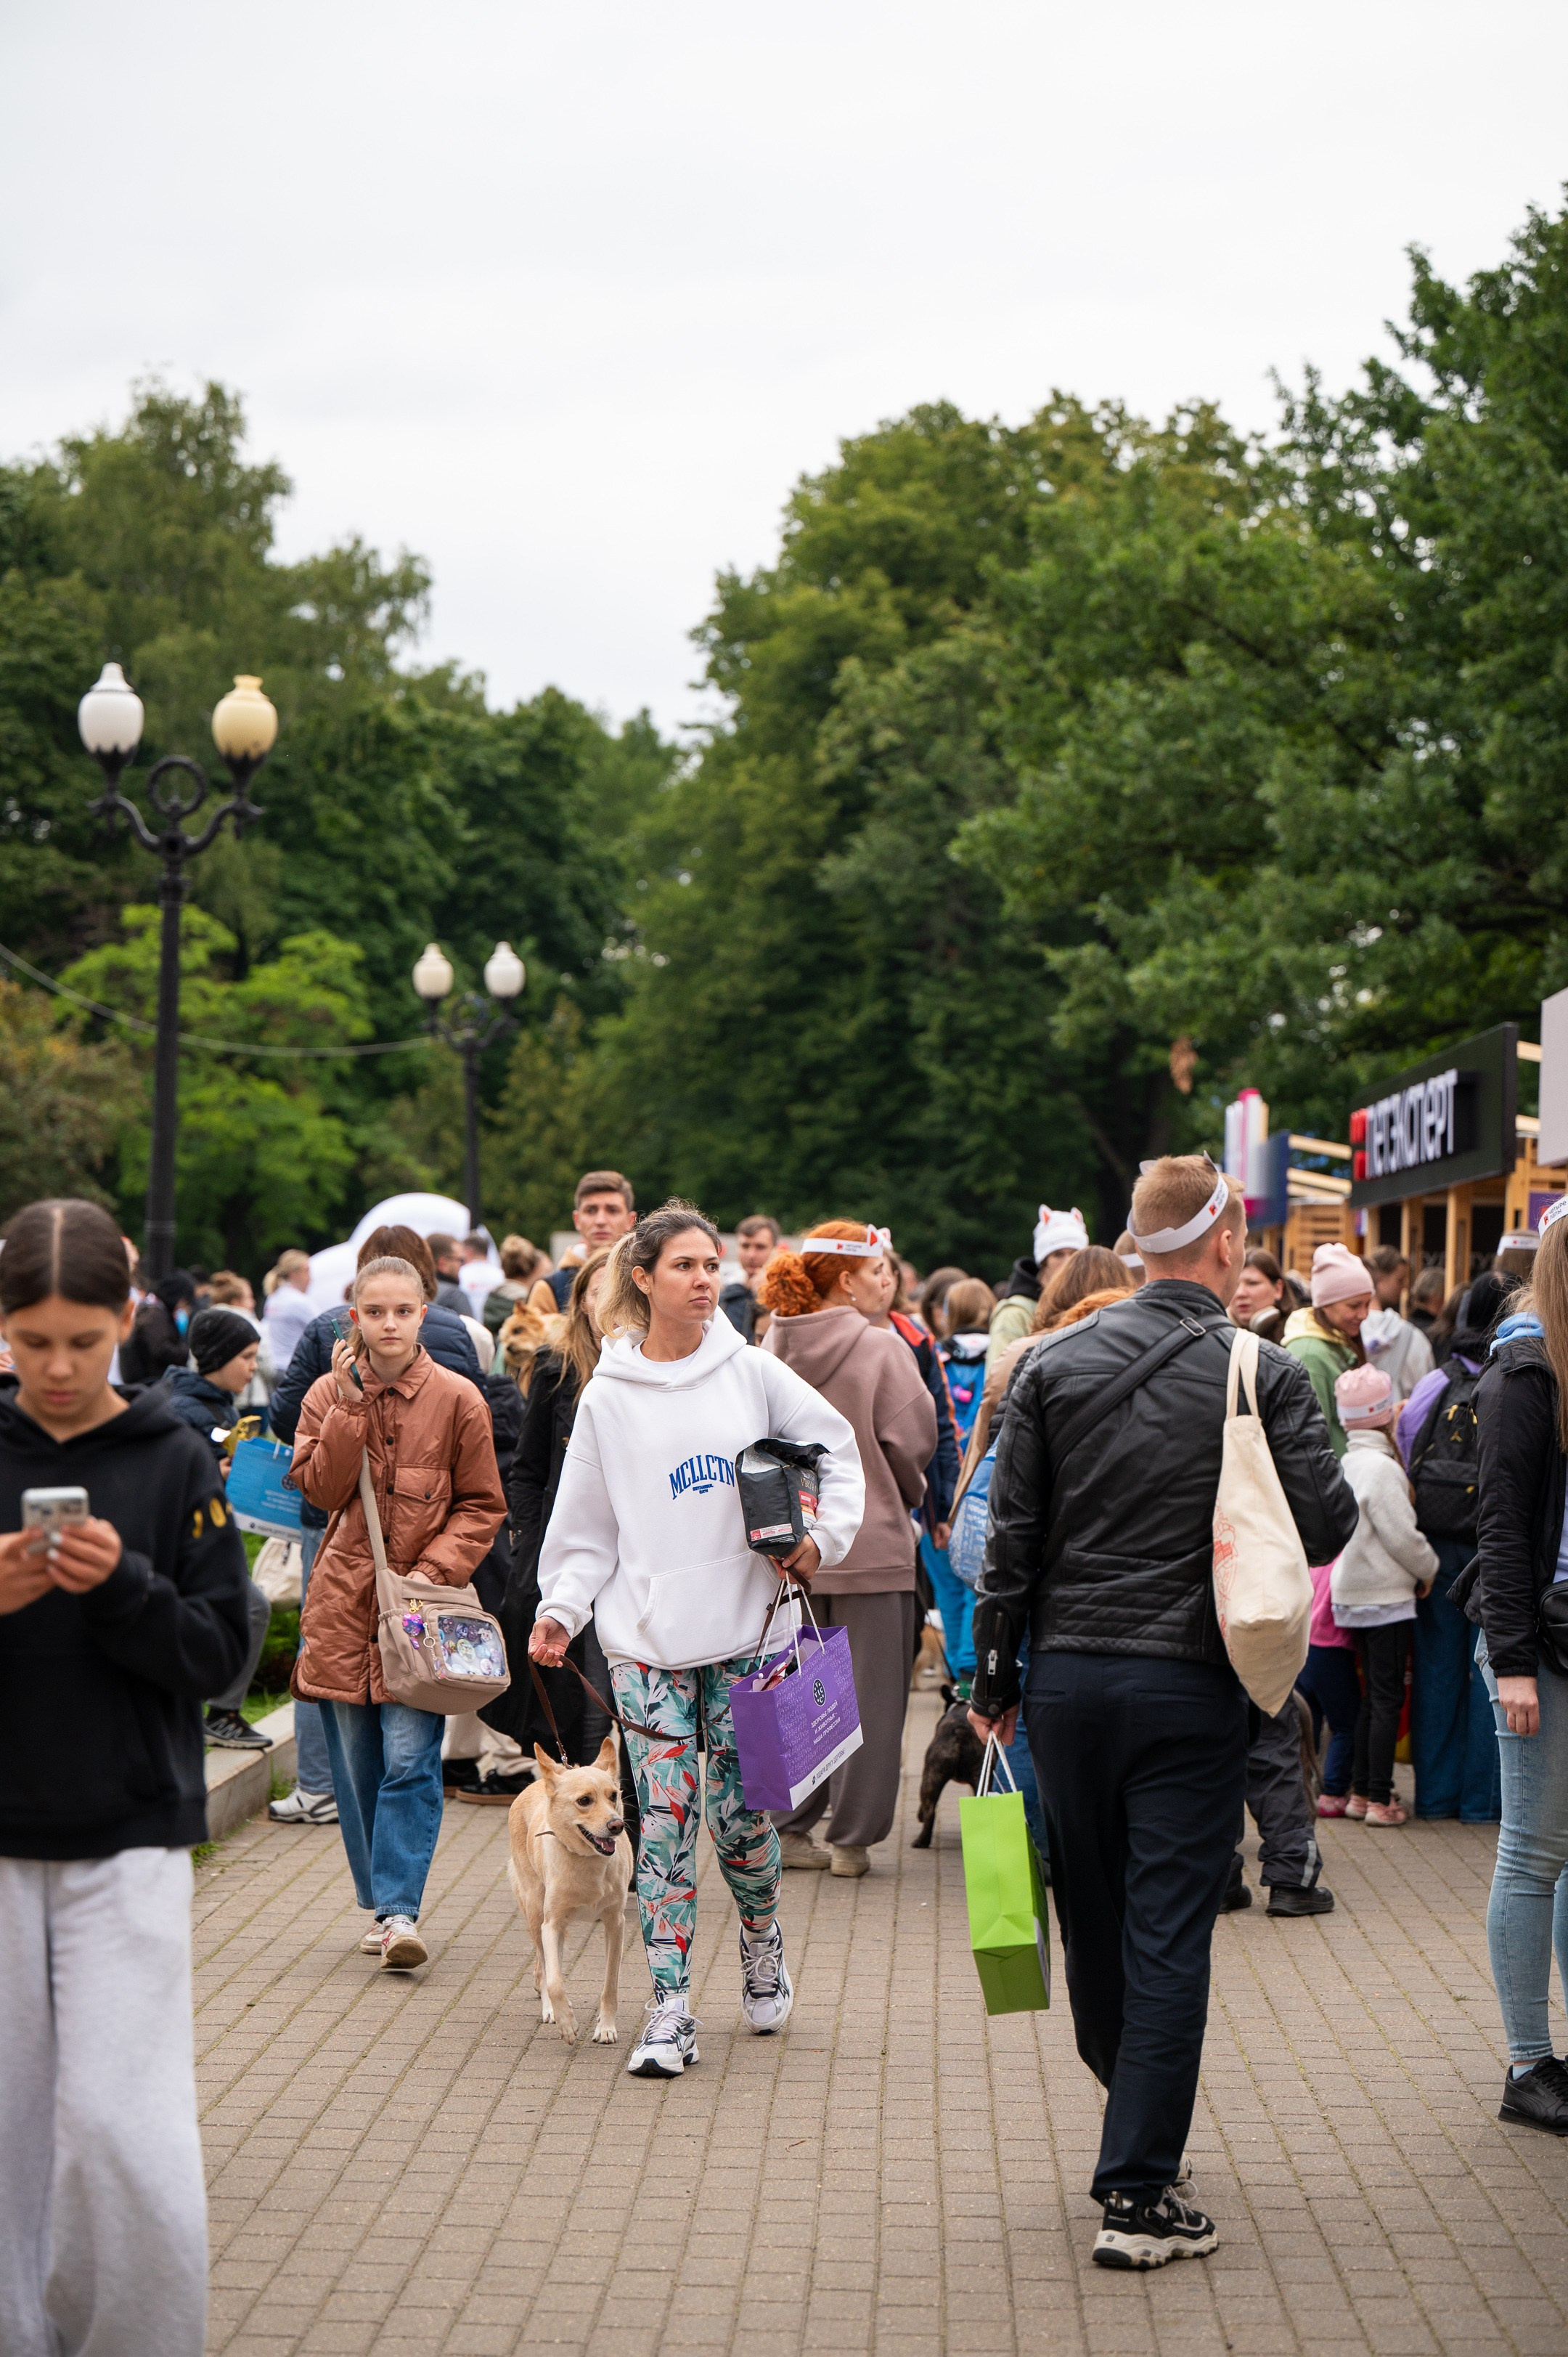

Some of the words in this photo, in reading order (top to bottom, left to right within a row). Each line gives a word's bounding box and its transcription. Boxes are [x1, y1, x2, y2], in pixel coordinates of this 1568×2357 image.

[669, 1454, 735, 1500] MCLLCTN
[811, 1711, 828, 1728] ЗДОРОВЬЕ
[827, 1699, 838, 1714] ЛЮДЕЙ
[817, 1712, 836, 1732] ЖИВОТНЫХ
[814, 1733, 823, 1746] НАША
[822, 1717, 841, 1737] ПРОФЕССИЯ
